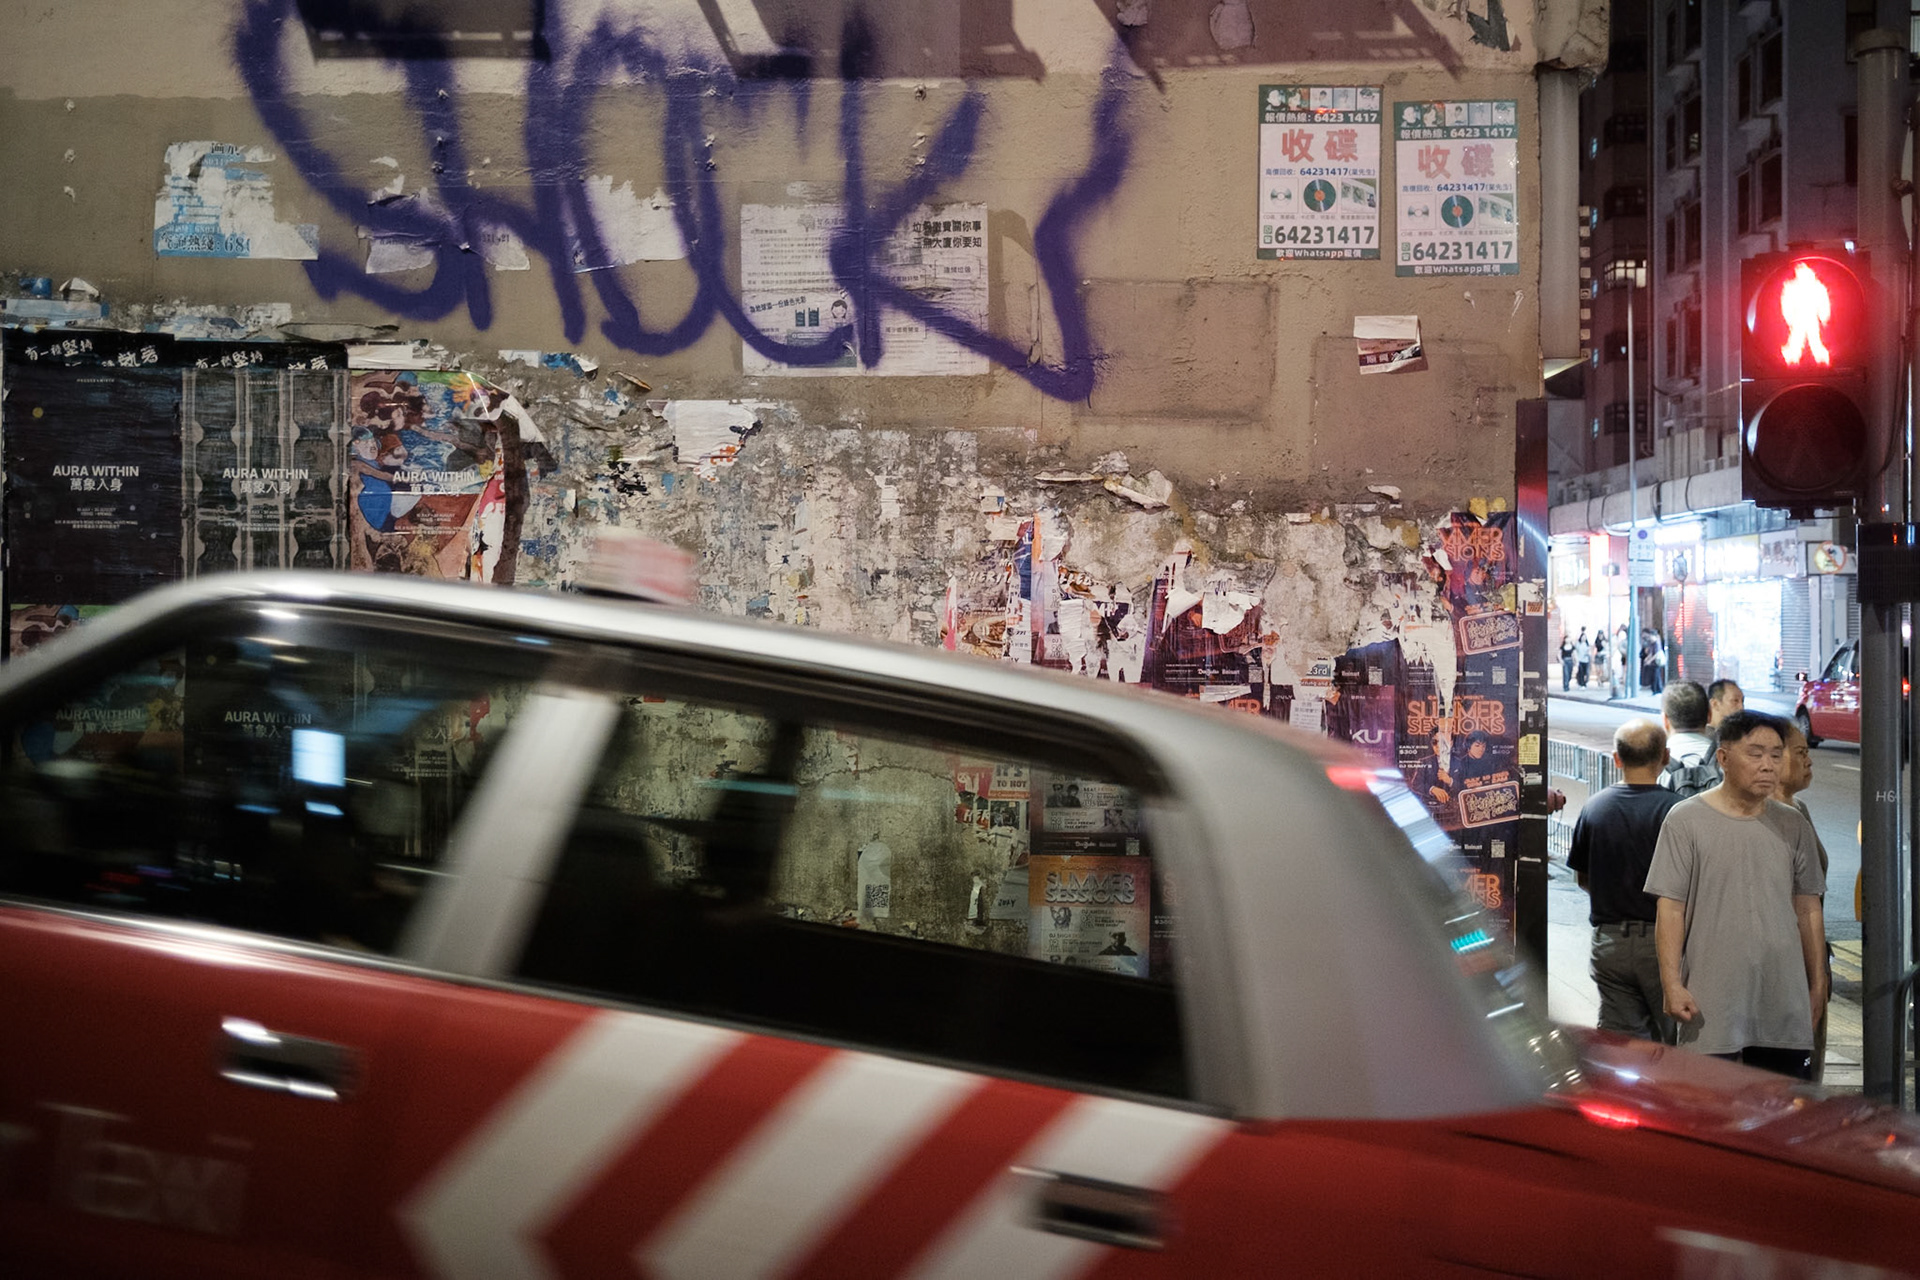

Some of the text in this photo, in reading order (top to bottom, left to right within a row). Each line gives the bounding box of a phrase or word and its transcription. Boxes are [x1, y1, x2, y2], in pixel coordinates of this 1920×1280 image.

[1314, 113, 1344, 122] 6423
[1348, 113, 1377, 122] 1417
[1450, 128, 1480, 138] 6423
[1484, 128, 1513, 137] 1417
[1281, 128, 1359, 163] 收碟
[1418, 144, 1495, 179] 收碟
[1274, 225, 1375, 245] 64231417
[1413, 241, 1513, 261] 64231417
[52, 465, 140, 477] AURA WITHIN
[222, 467, 309, 480] AURA WITHIN
[392, 471, 475, 482] AURA WITHIN
[70, 478, 123, 492] 萬象入身
[240, 480, 292, 494] 萬象入身
[55, 708, 142, 720] AURA WITHIN
[225, 711, 260, 723] AURA
[1407, 701, 1504, 719] SUMER
[241, 723, 292, 738] 萬象入
[1407, 717, 1506, 735] SESIONS
[1875, 790, 1897, 803] H6
[1046, 872, 1135, 890] SUMMER
[1045, 888, 1136, 905] SESSIONS
